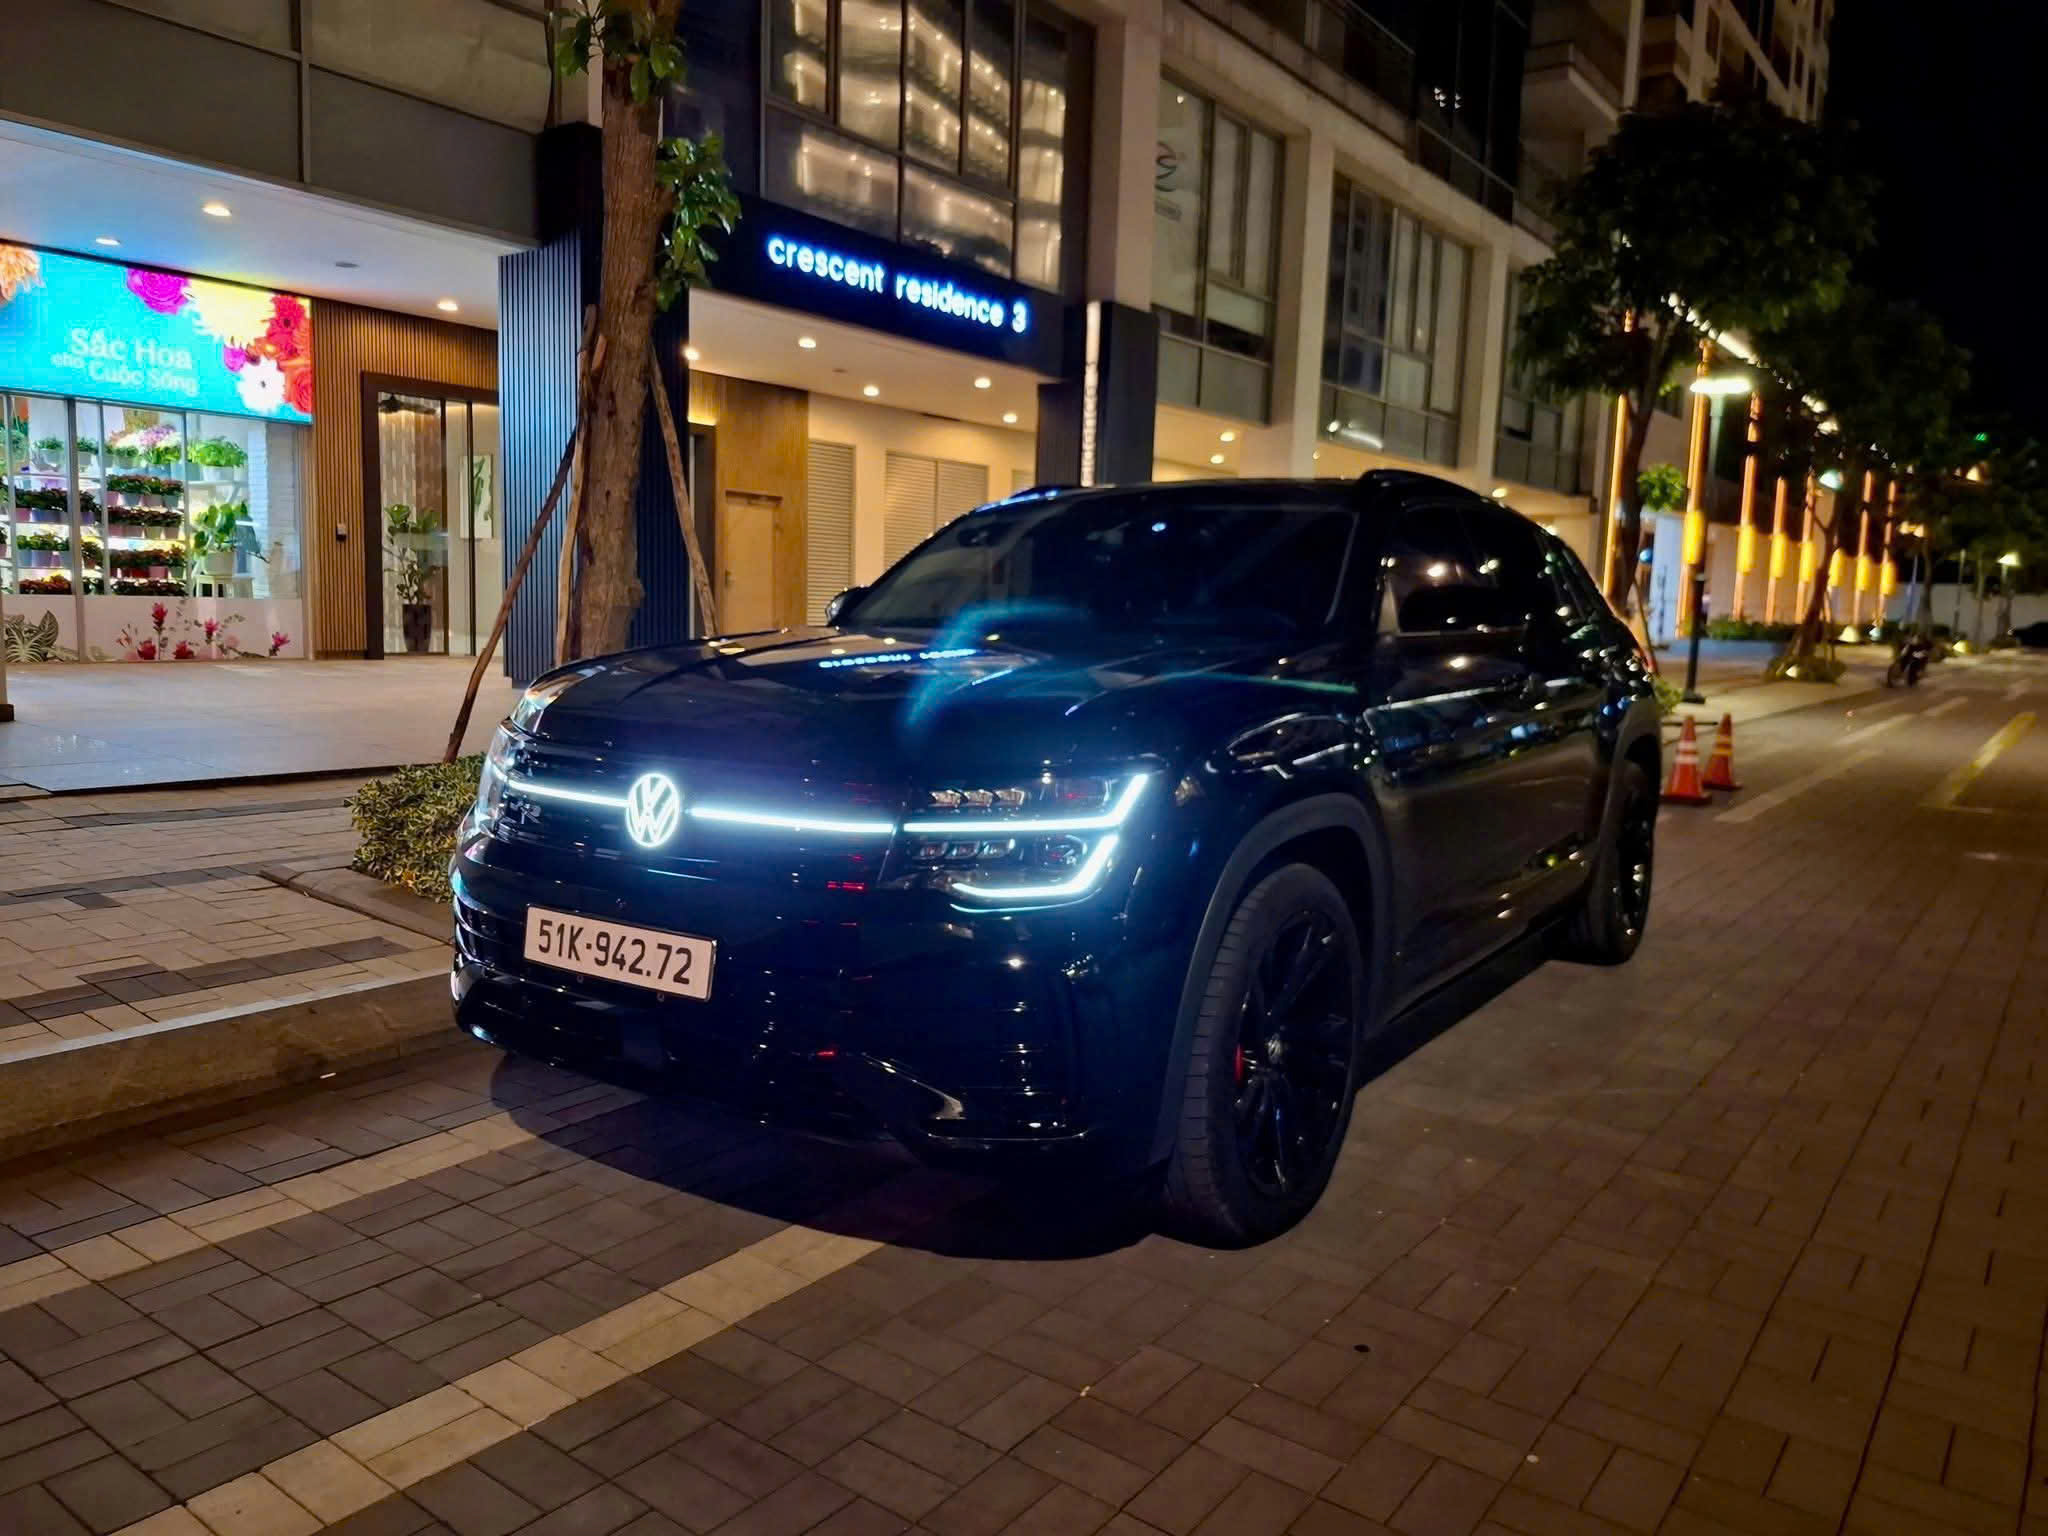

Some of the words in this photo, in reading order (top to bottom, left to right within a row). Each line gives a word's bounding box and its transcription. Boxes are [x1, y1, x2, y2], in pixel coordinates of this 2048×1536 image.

[767, 237, 885, 293] crescent
[895, 273, 1004, 328] residence
[1011, 301, 1027, 333] 3
[135, 338, 192, 370] Hoa
[537, 918, 693, 986] 51K-942.72
